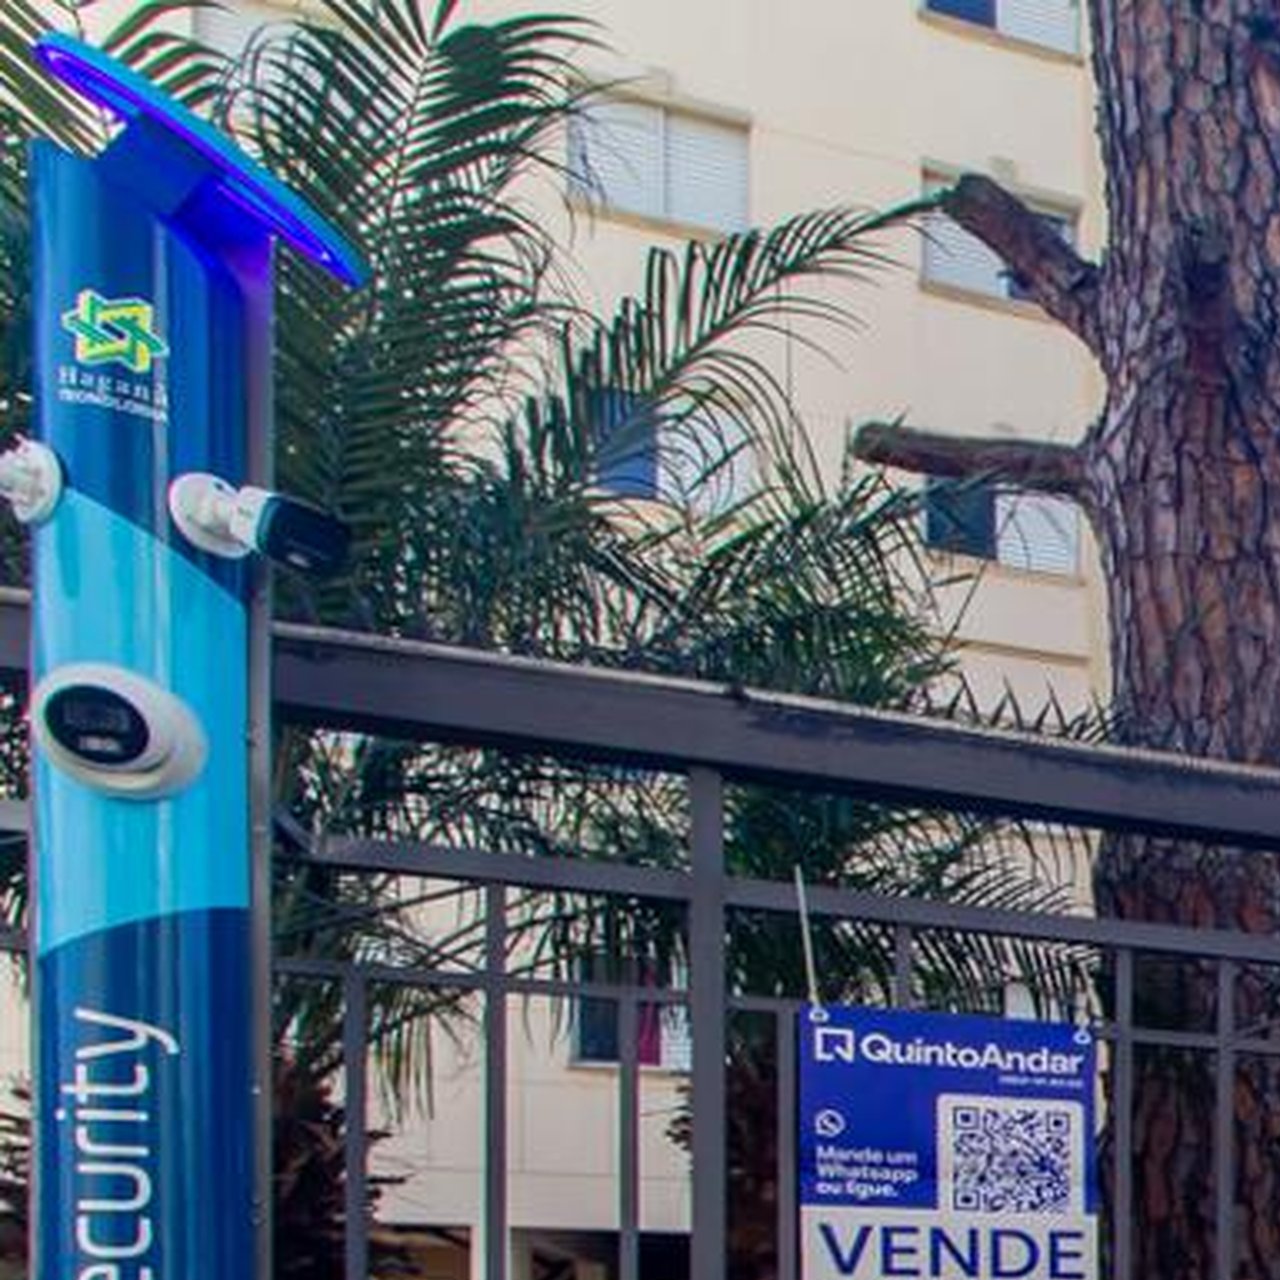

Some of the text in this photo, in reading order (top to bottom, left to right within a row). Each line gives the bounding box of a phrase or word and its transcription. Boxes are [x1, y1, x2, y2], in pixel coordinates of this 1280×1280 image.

[861, 1033, 1085, 1076] QuintoAndar
[816, 1145, 918, 1166] Mande um
[815, 1181, 842, 1195] ou
[818, 1222, 1086, 1280] VENDE
